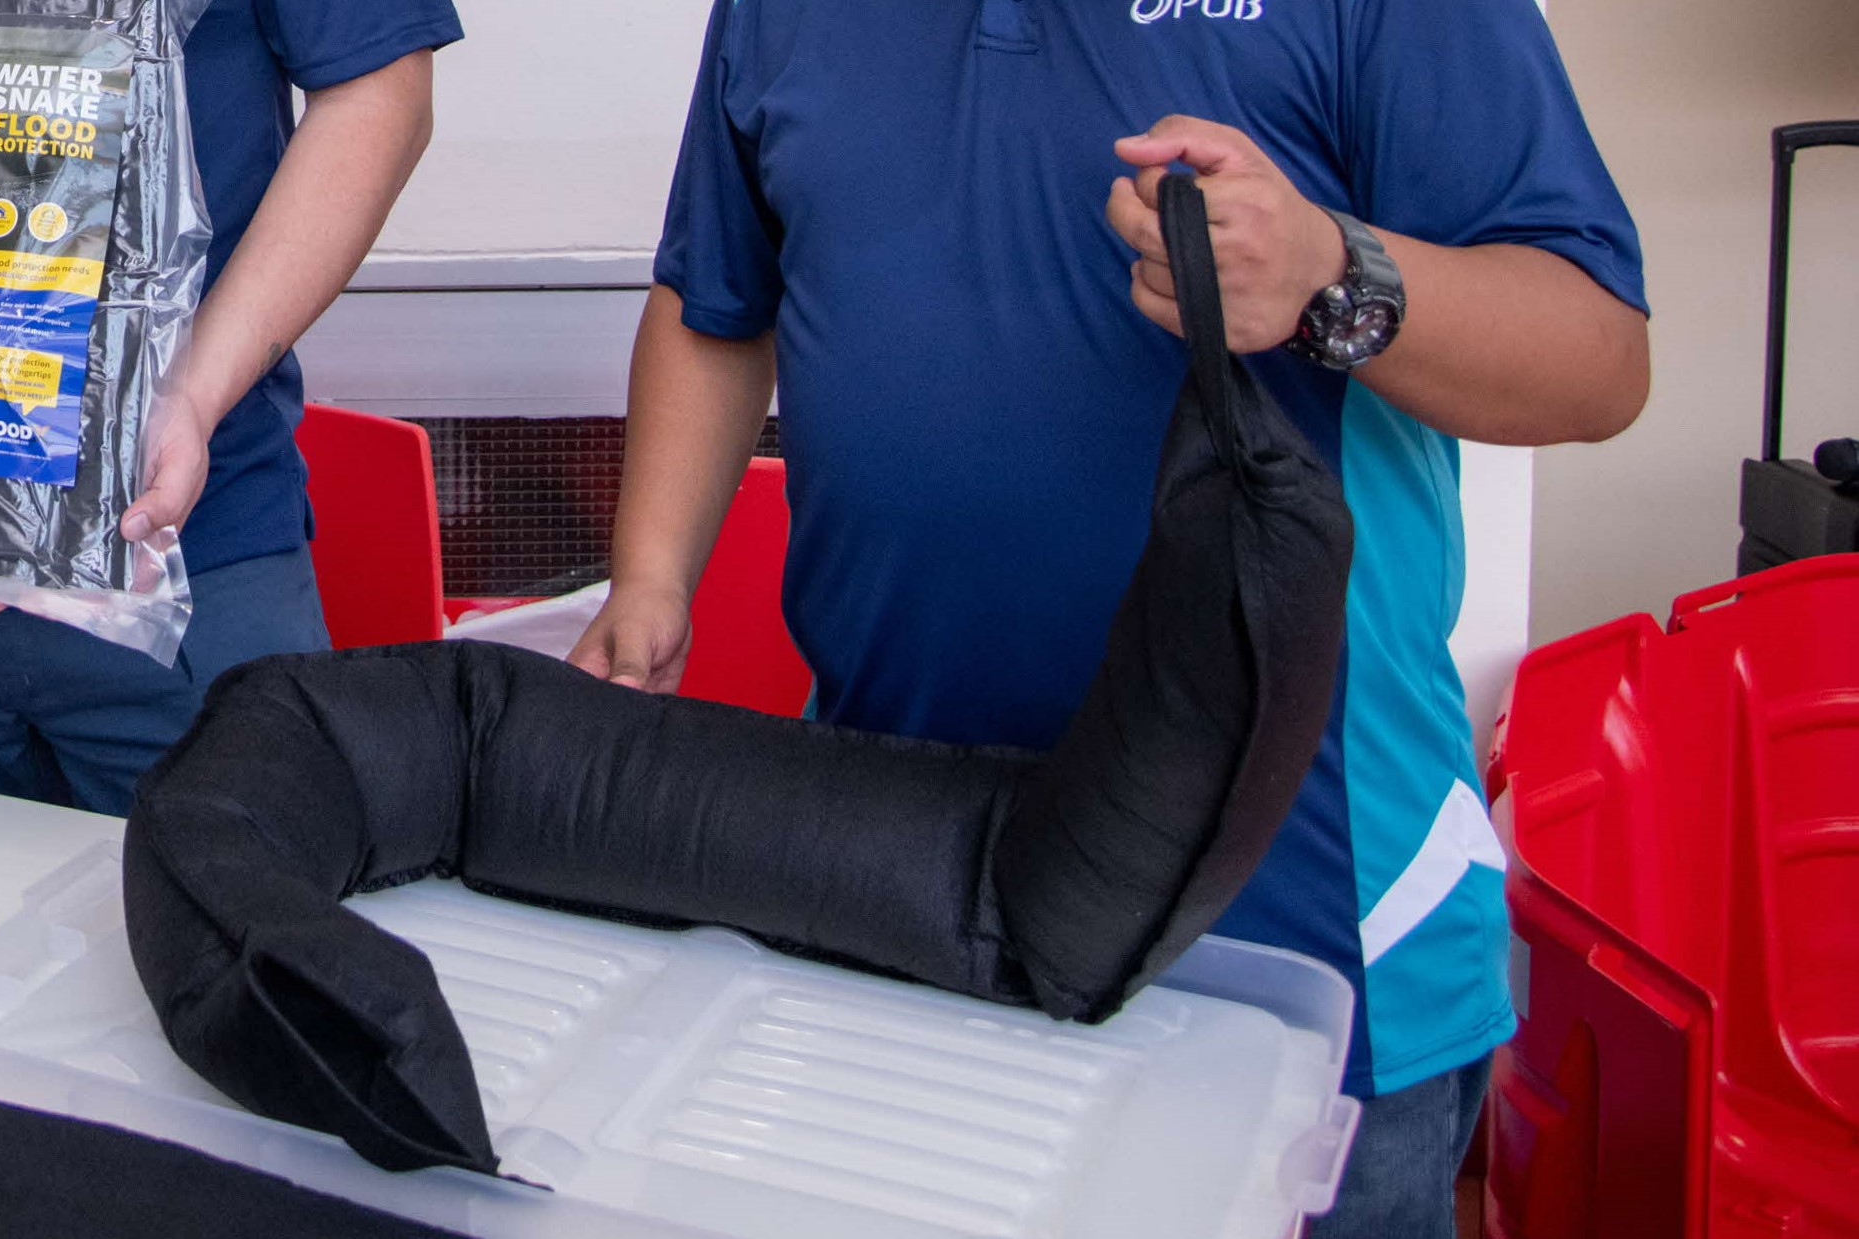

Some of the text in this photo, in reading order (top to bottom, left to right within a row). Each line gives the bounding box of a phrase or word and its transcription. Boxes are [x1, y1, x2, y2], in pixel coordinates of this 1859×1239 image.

[12, 262, 60, 273] protection
[62, 266, 90, 275] needs
[30, 274, 58, 282] control
[9, 356, 50, 368] protection
[13, 368, 51, 379] fingertips
